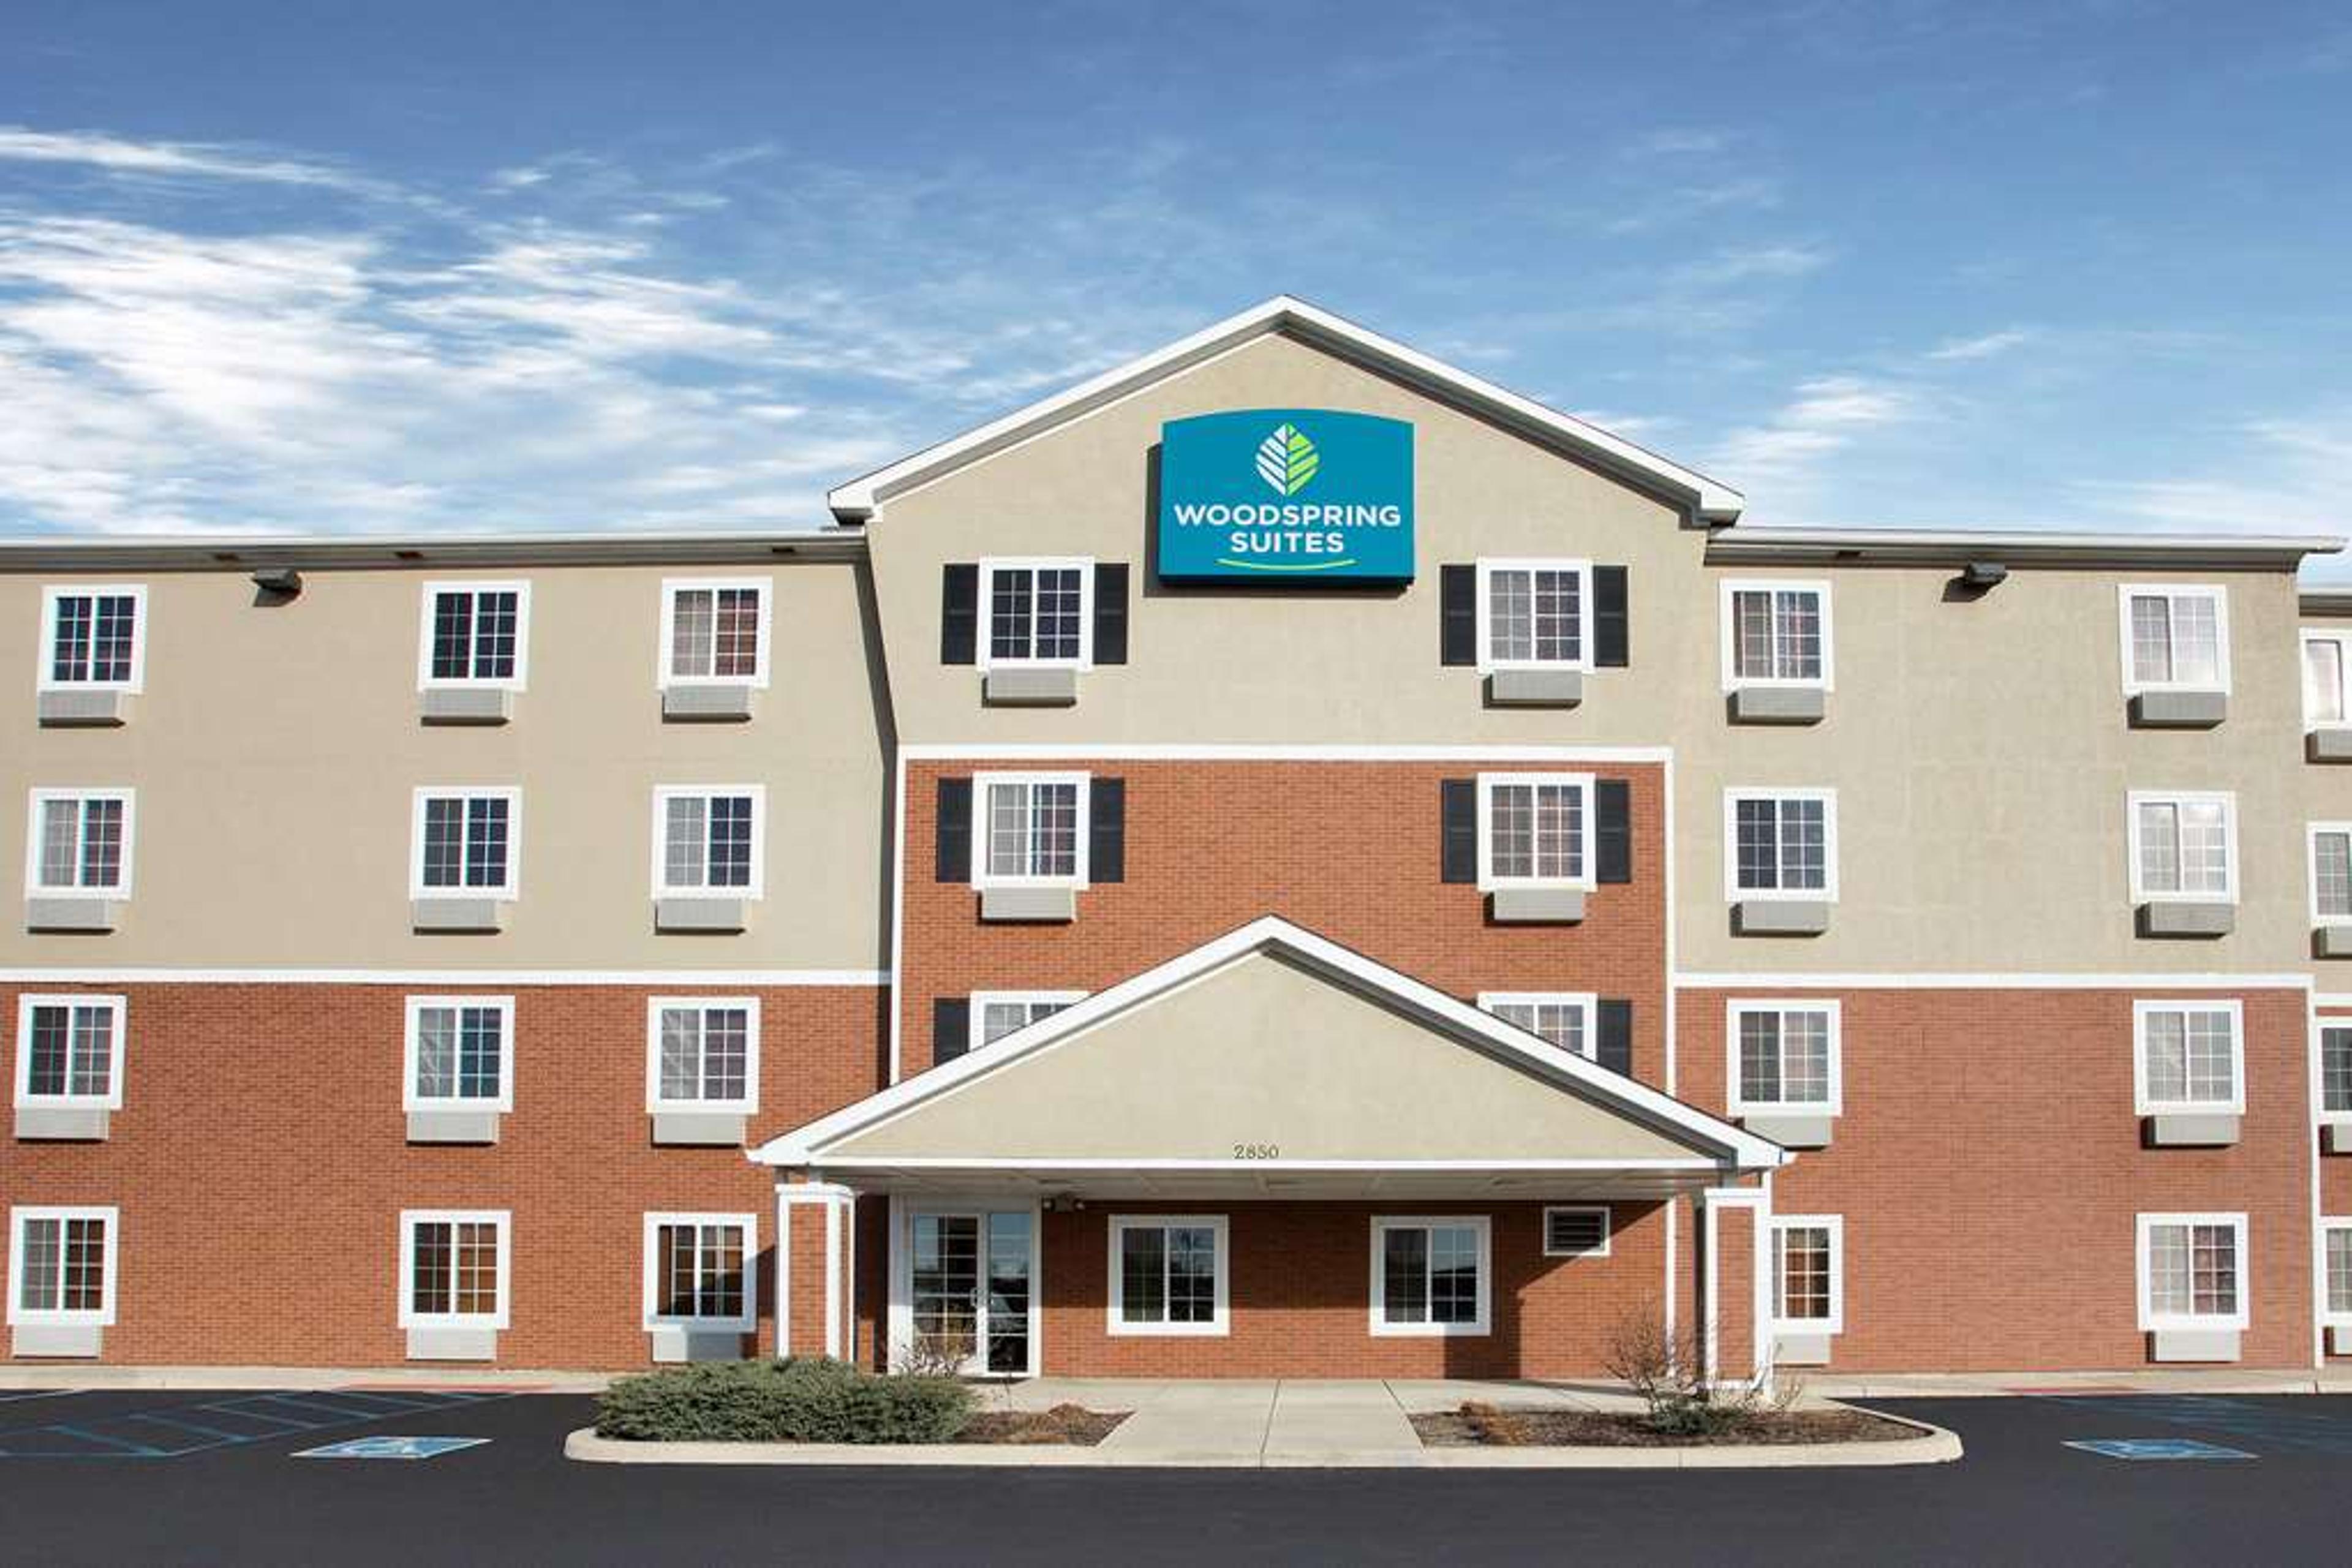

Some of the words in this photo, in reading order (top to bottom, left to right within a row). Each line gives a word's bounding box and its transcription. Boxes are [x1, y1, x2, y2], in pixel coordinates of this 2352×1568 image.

[1174, 504, 1401, 527] WOODSPRING
[1230, 531, 1344, 553] SUITES
[1234, 1144, 1279, 1159] 2850
